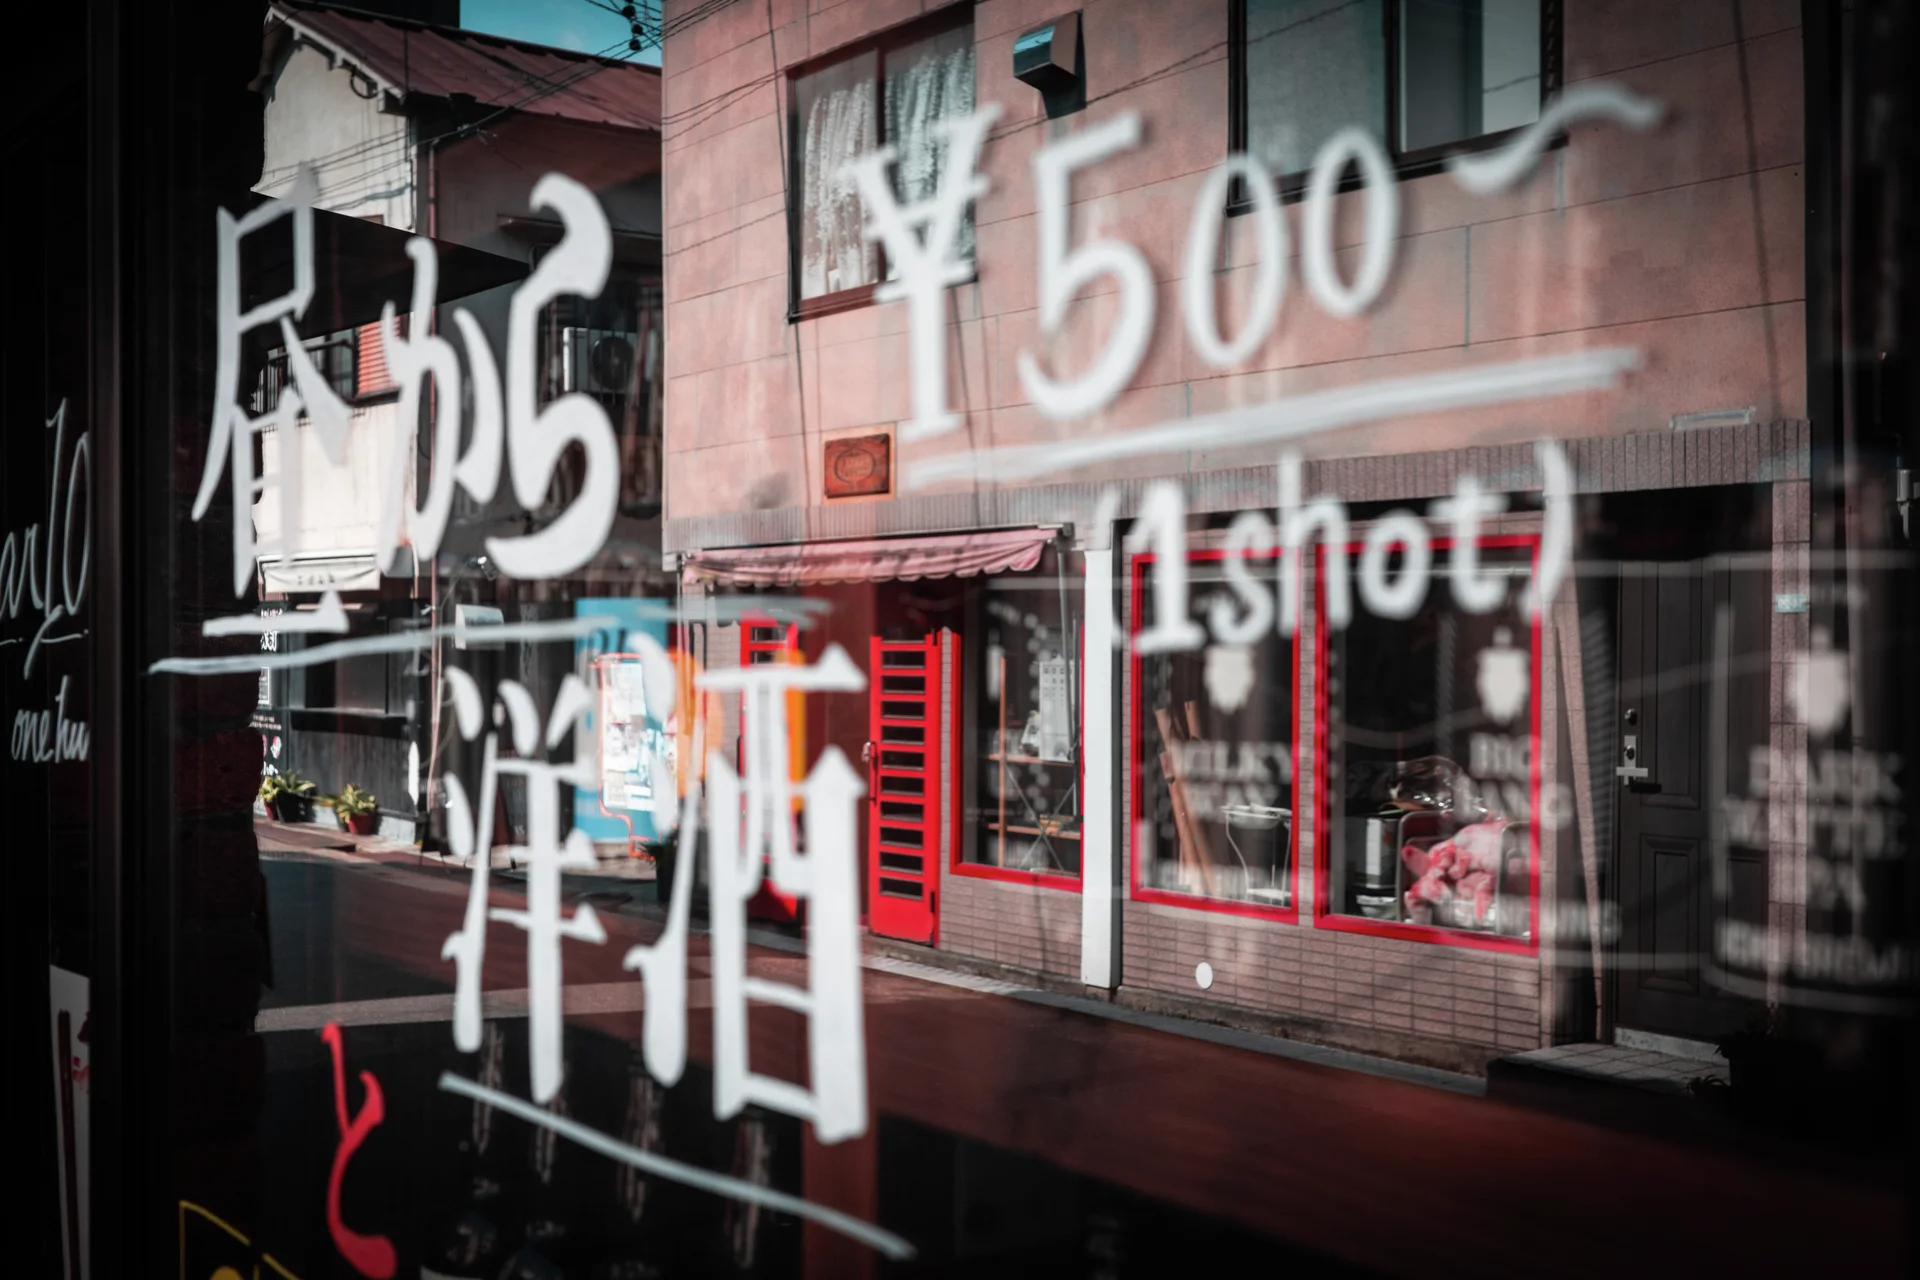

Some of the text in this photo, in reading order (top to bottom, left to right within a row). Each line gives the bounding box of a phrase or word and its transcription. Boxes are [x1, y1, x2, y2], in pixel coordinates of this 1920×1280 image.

[192, 162, 620, 635] 昼から
[441, 630, 868, 1143] 洋酒
